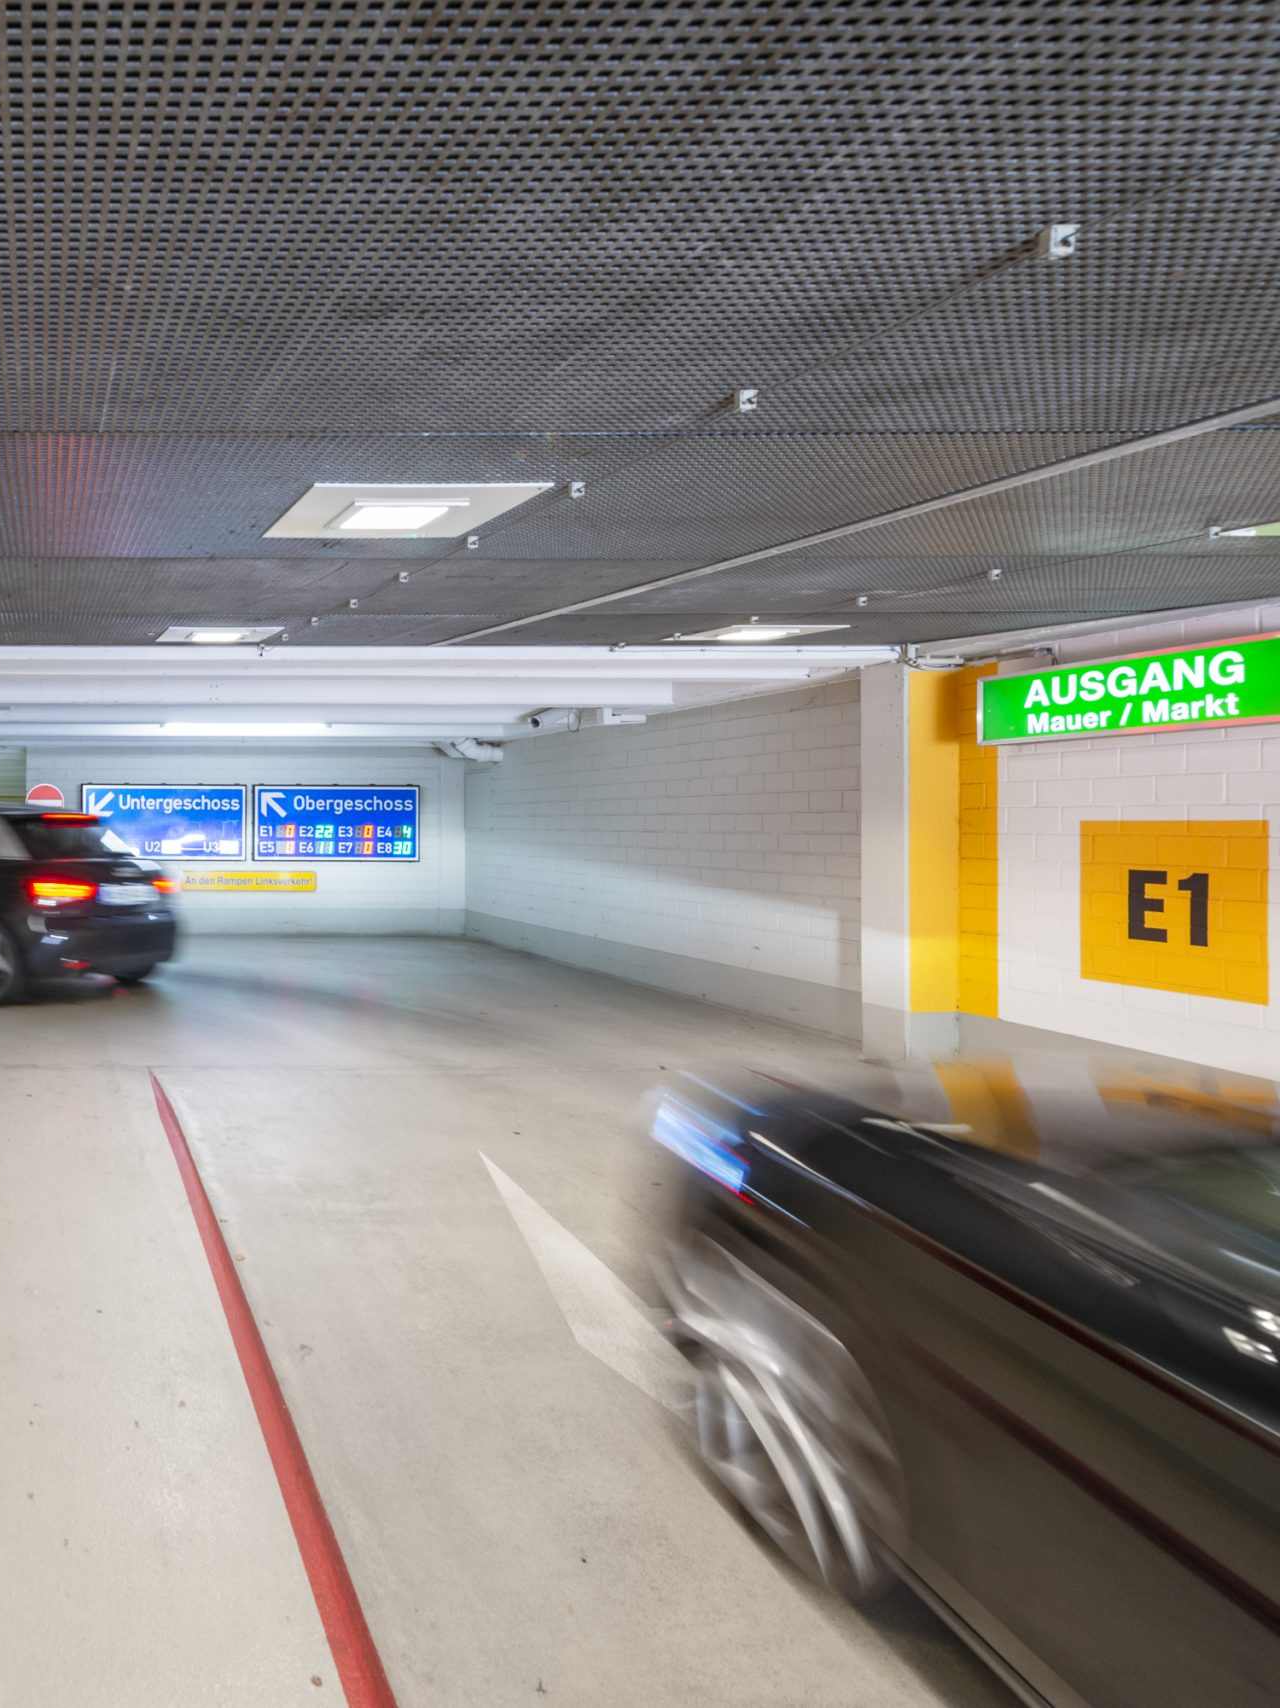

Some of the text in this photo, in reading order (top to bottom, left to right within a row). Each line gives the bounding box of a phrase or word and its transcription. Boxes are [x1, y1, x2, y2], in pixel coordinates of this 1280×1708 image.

[1024, 650, 1246, 708] AUSGANG
[1027, 692, 1240, 734] Mauer / Markt
[118, 794, 240, 813] Untergeschoss
[293, 795, 413, 814] Obergeschoss
[259, 825, 273, 838] E1
[299, 825, 314, 838] E2
[315, 825, 334, 838] 22
[338, 825, 353, 838] E3
[363, 825, 374, 838] 0
[377, 825, 393, 838] E4
[402, 825, 412, 838] 4
[144, 840, 218, 853] U2 U3
[259, 841, 274, 854] E5
[299, 841, 314, 854] E6
[319, 841, 334, 854] 11
[338, 841, 353, 854] E7
[363, 841, 374, 854] 0
[377, 841, 393, 854] E8
[394, 841, 413, 854] 30
[185, 876, 313, 887] An den Rampen Linksverkehr!
[1127, 869, 1209, 947] E1
